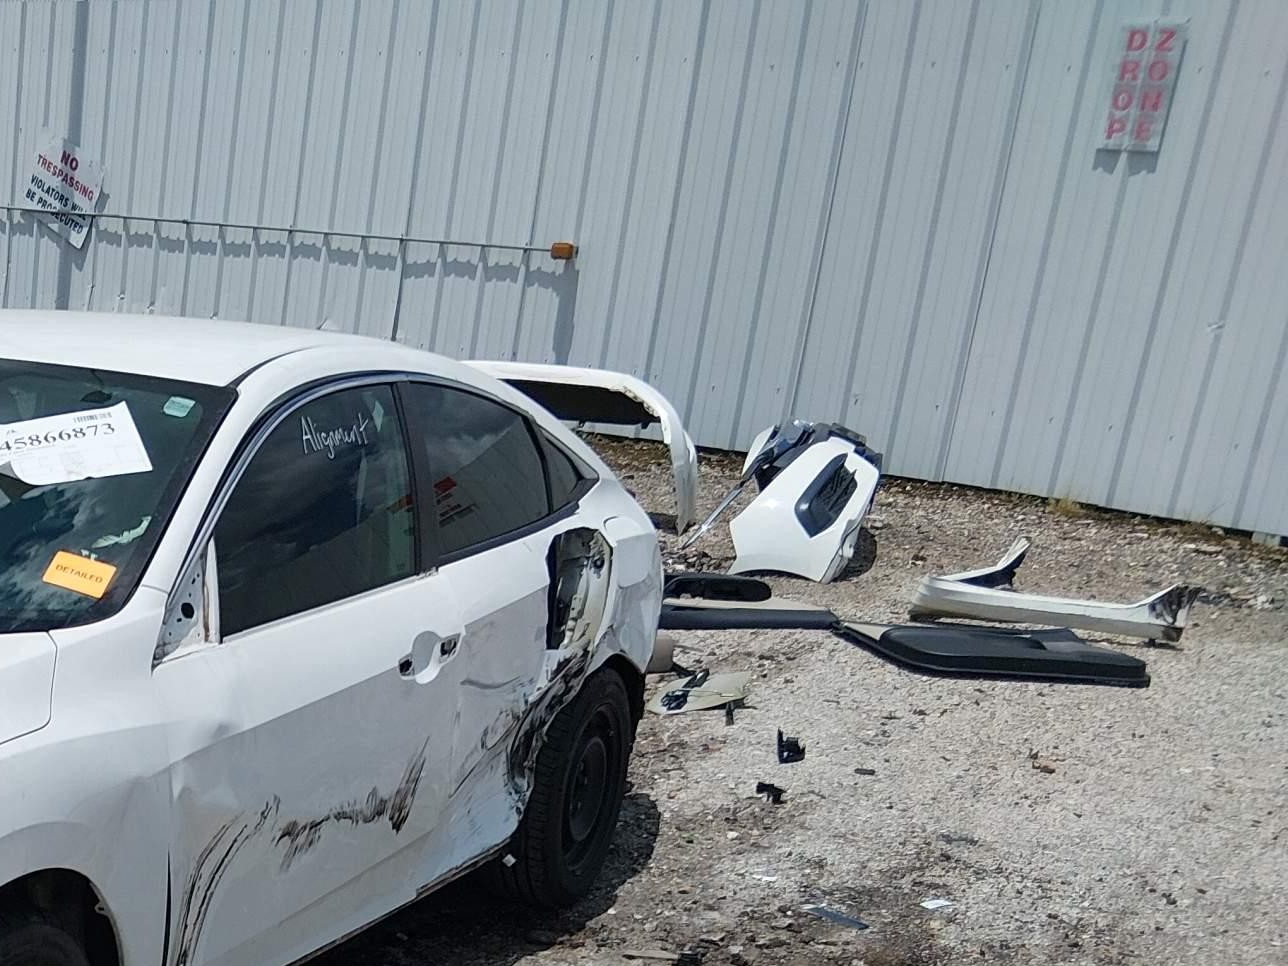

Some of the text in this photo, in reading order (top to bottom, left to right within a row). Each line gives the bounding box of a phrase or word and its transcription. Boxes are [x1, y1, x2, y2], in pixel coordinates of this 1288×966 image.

[1105, 28, 1148, 140] DROP
[1133, 27, 1177, 142] ZONE
[37, 153, 95, 202] TRESPASSING
[60, 150, 79, 172] NO
[25, 187, 37, 202] BE
[30, 173, 70, 208] VIOLATORS
[0, 422, 116, 452] 45866873
[299, 412, 369, 460] Alignment
[54, 563, 104, 584] DETAILED
